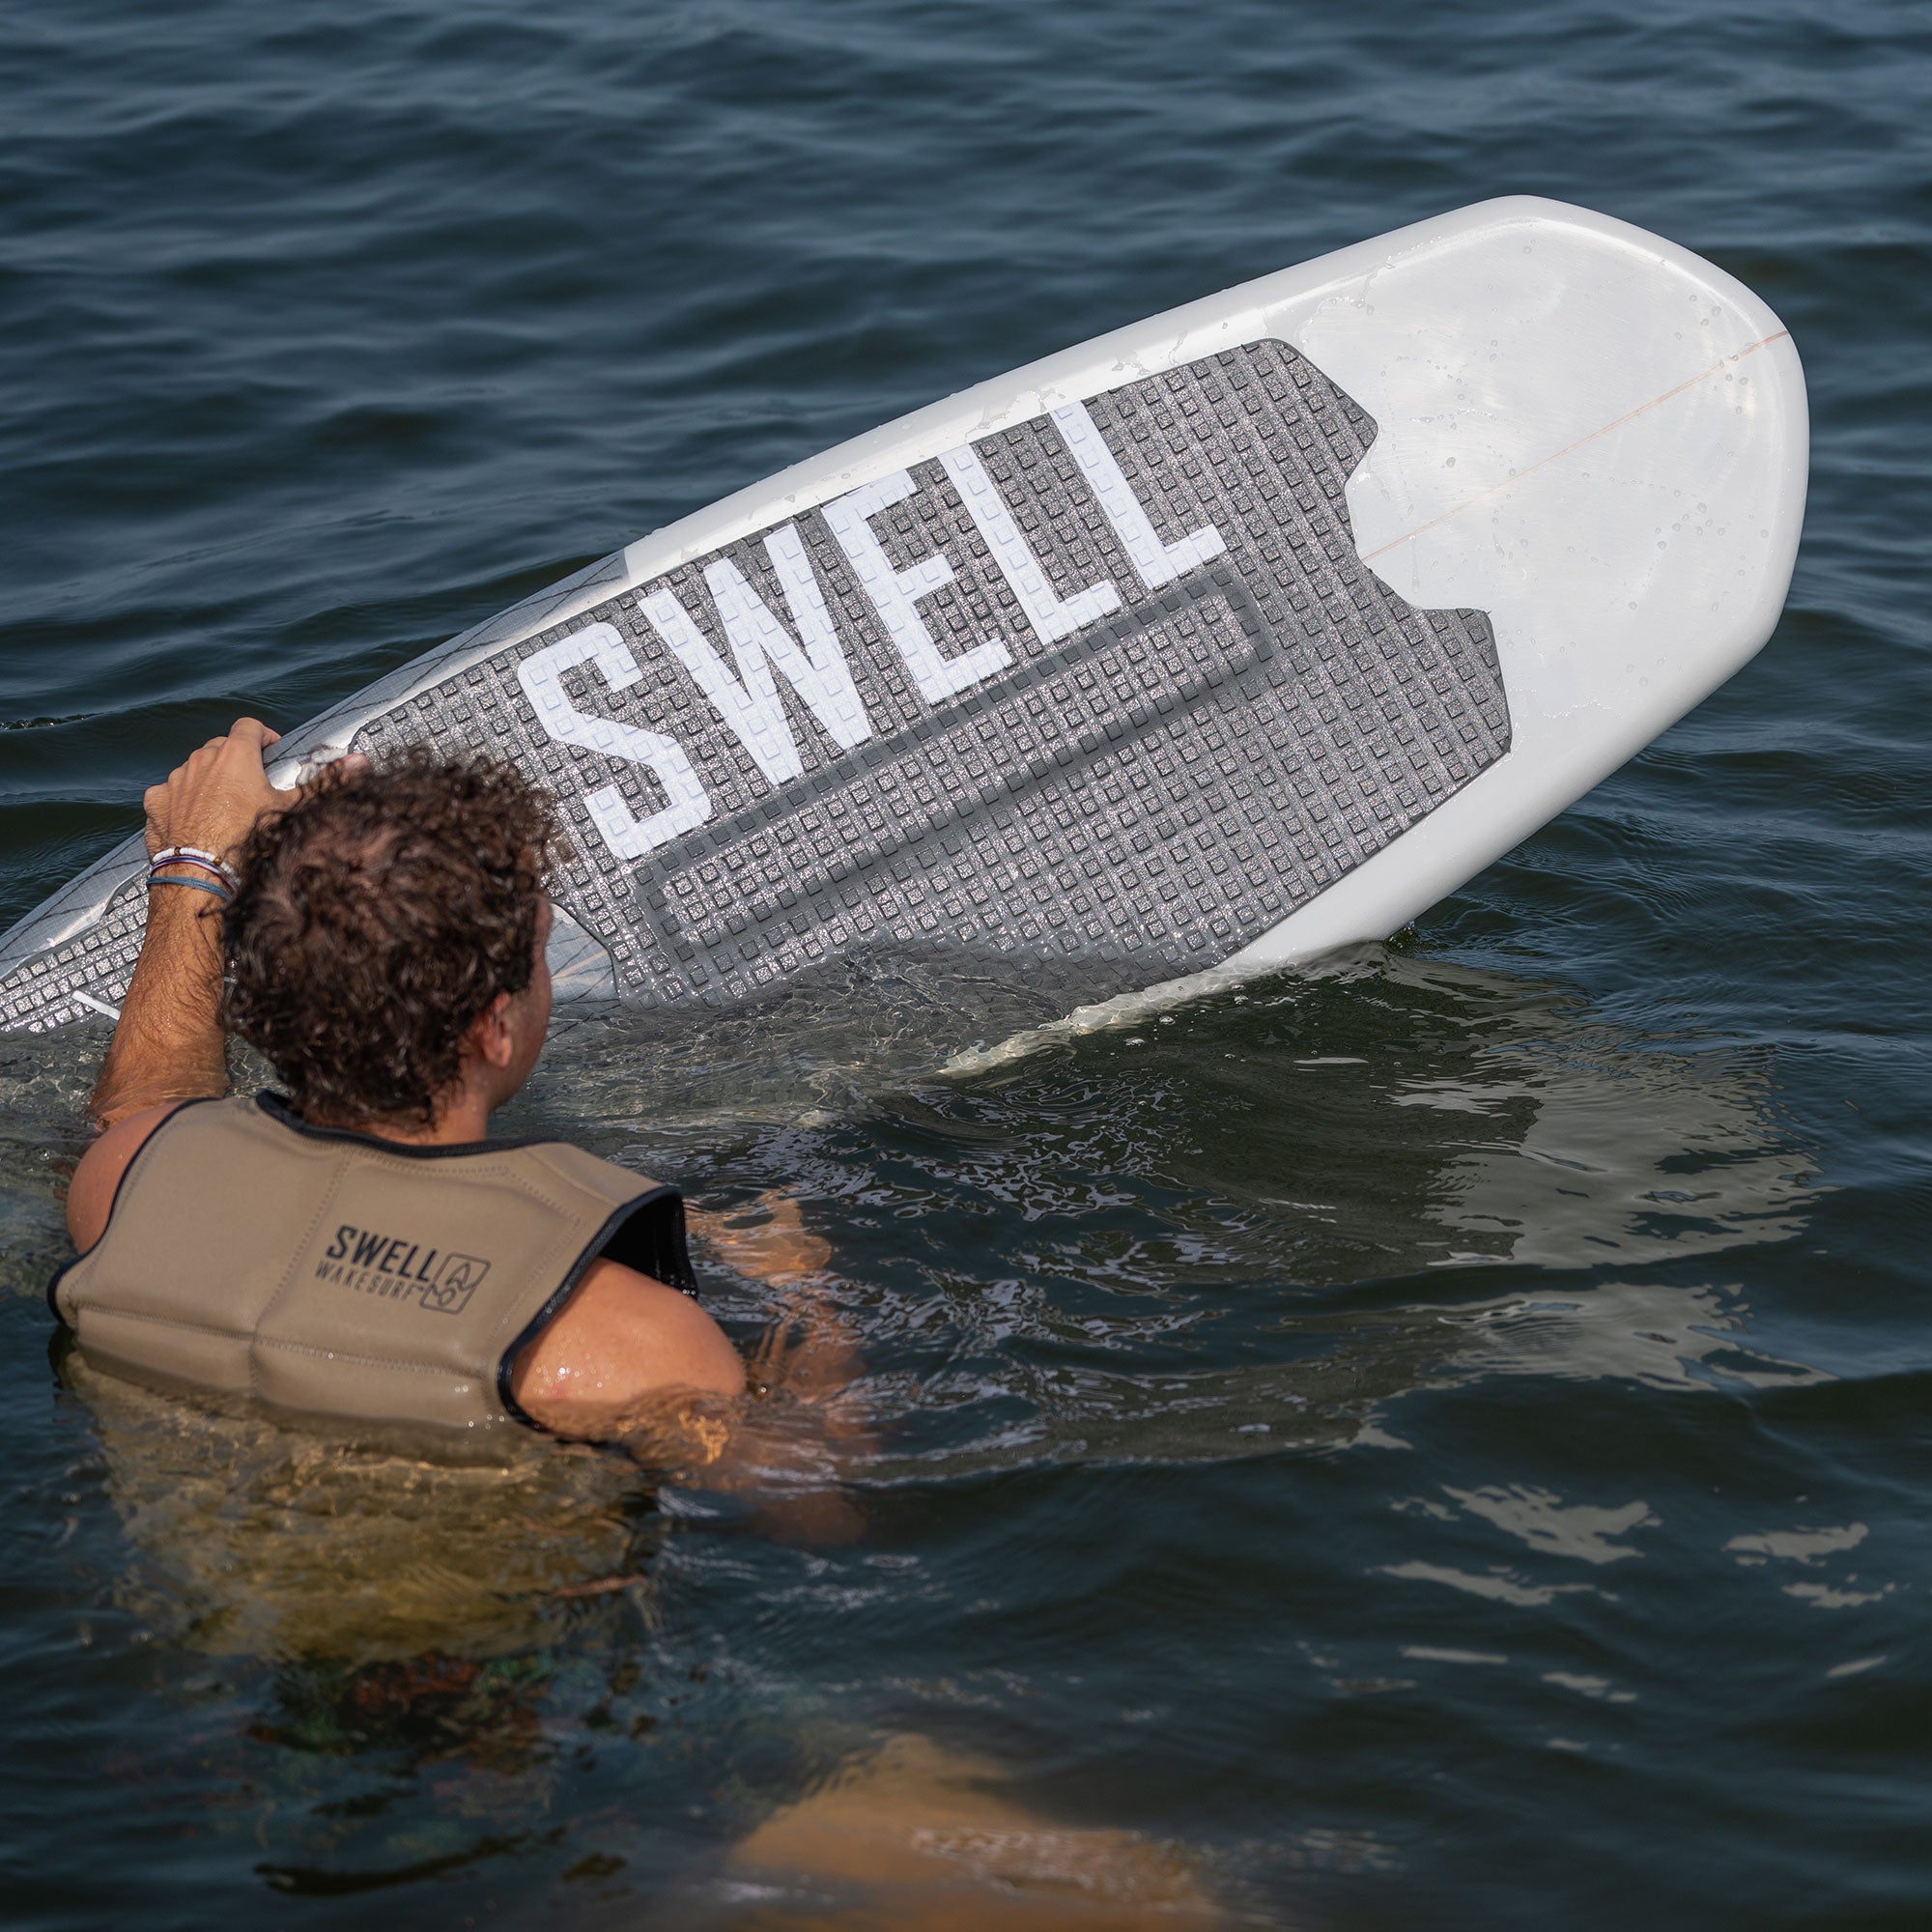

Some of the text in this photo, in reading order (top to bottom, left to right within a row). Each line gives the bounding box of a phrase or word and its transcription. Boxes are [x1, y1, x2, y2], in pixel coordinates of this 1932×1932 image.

[517, 401, 1227, 860] SWELL
[315, 1260, 419, 1300] WAKESURF
[326, 1224, 437, 1283] SWELL
